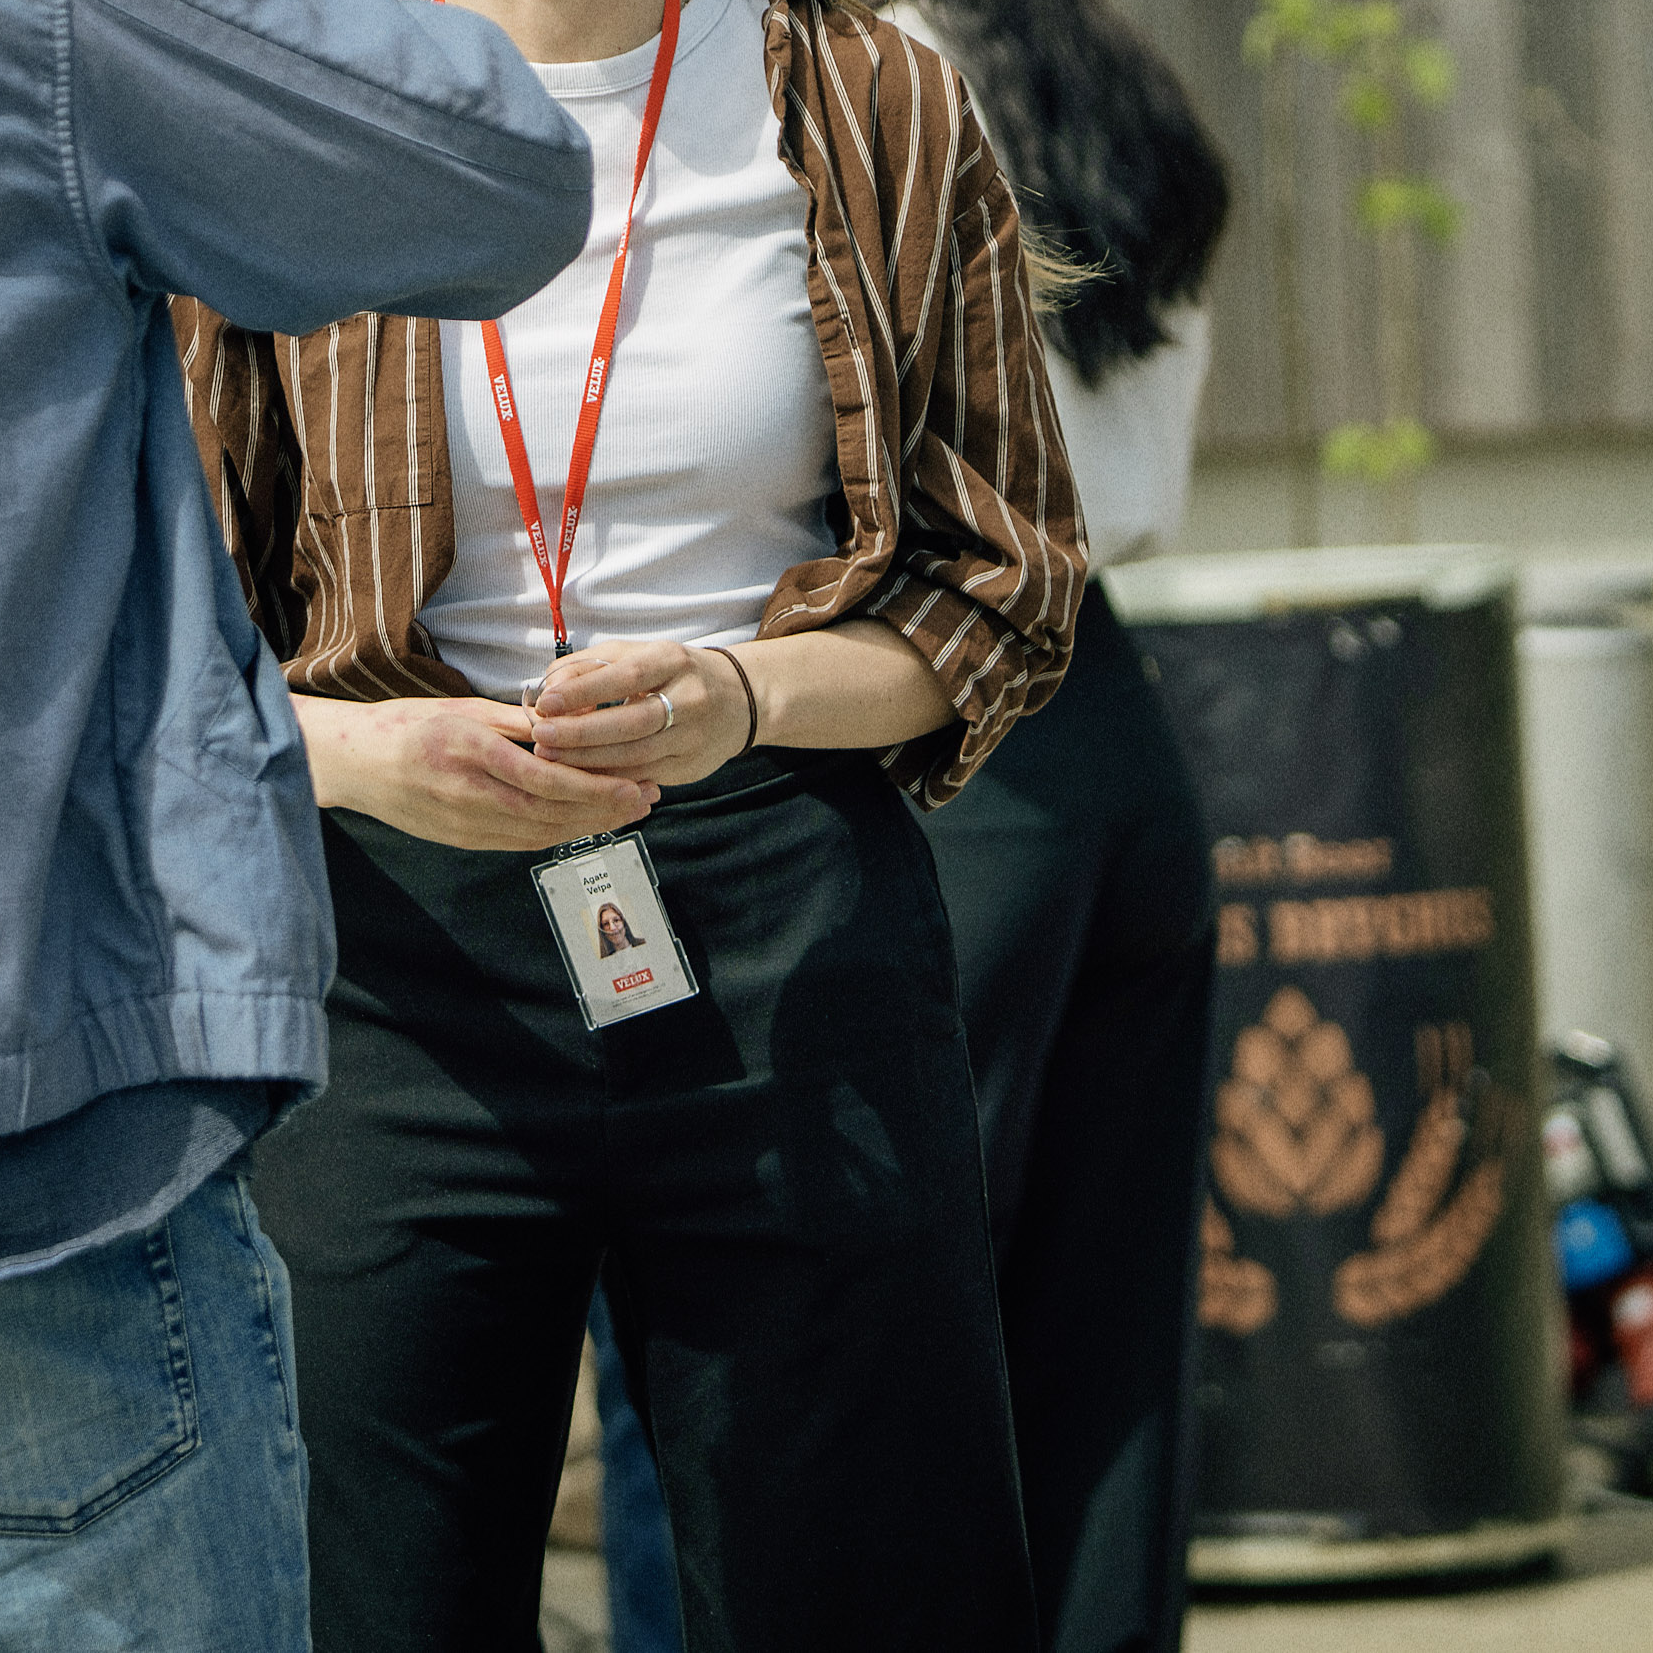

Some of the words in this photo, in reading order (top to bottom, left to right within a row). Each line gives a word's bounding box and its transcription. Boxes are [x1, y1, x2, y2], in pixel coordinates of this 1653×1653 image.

[493, 373, 513, 422] VELUX
[586, 356, 606, 403] VELUX
[530, 519, 548, 567] VELUX
[562, 505, 578, 553] VELUX
[583, 871, 608, 885] Agate
[615, 970, 650, 990] VELUX
